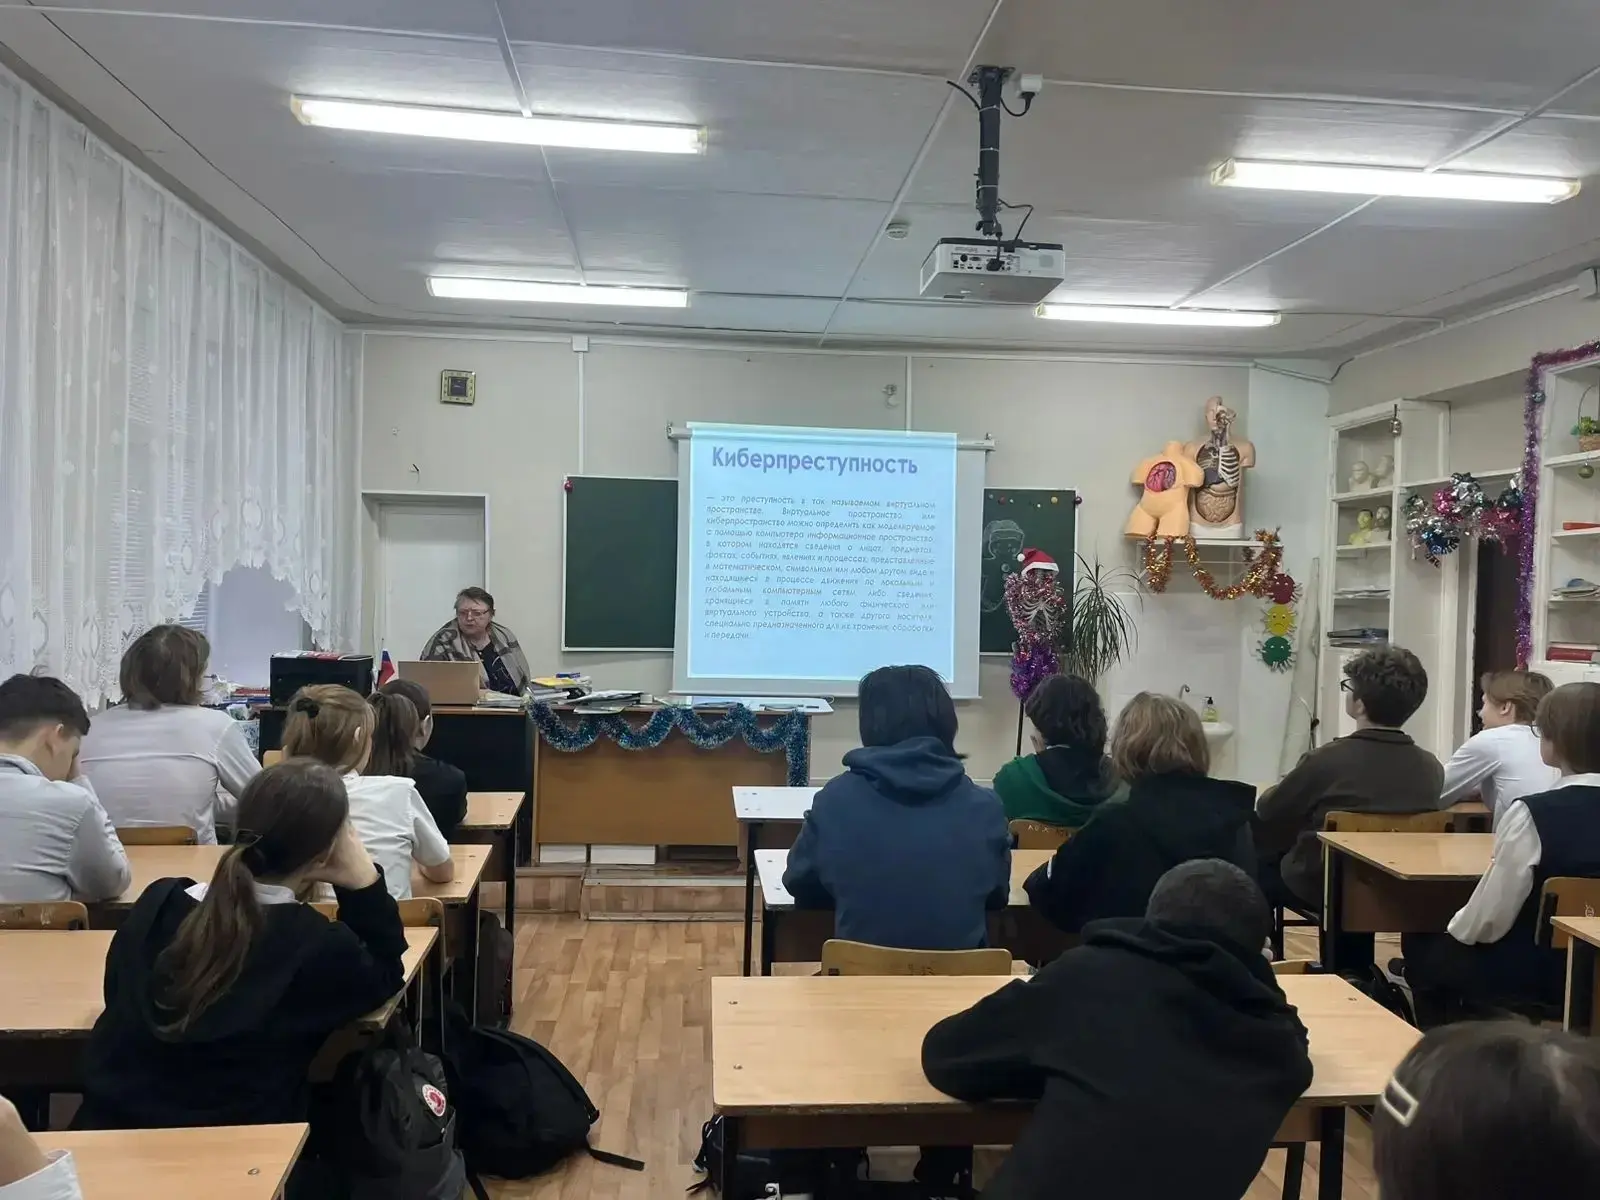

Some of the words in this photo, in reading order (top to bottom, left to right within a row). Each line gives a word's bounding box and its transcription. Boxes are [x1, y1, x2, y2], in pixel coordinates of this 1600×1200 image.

[712, 446, 918, 476] Киберпреступность
[721, 495, 735, 503] это
[741, 495, 795, 505] преступность
[831, 498, 880, 507] называемом
[886, 500, 936, 509] виртуальном
[782, 507, 831, 517] Виртуальное
[706, 516, 785, 527] киберпространство
[787, 519, 814, 527] можно
[815, 520, 860, 529] определить
[877, 523, 936, 532] моделируемое
[714, 529, 753, 537] помощью
[755, 530, 804, 539] компьютера
[807, 531, 876, 541] информационное
[871, 557, 936, 565] представленные
[785, 565, 833, 573] символьном
[851, 566, 877, 574] любом
[879, 568, 906, 576] другом
[705, 575, 758, 583] находящиеся
[776, 576, 815, 584] процессе
[881, 579, 922, 587] локальным
[705, 585, 752, 594] глобальным
[762, 587, 822, 596] компьютерным
[705, 598, 754, 606] хранящиеся
[820, 599, 849, 607] любого
[860, 600, 909, 609] физического
[705, 609, 757, 618] виртуального
[861, 612, 890, 620] другого
[704, 619, 751, 629] специально
[752, 620, 825, 630] предназначенного
